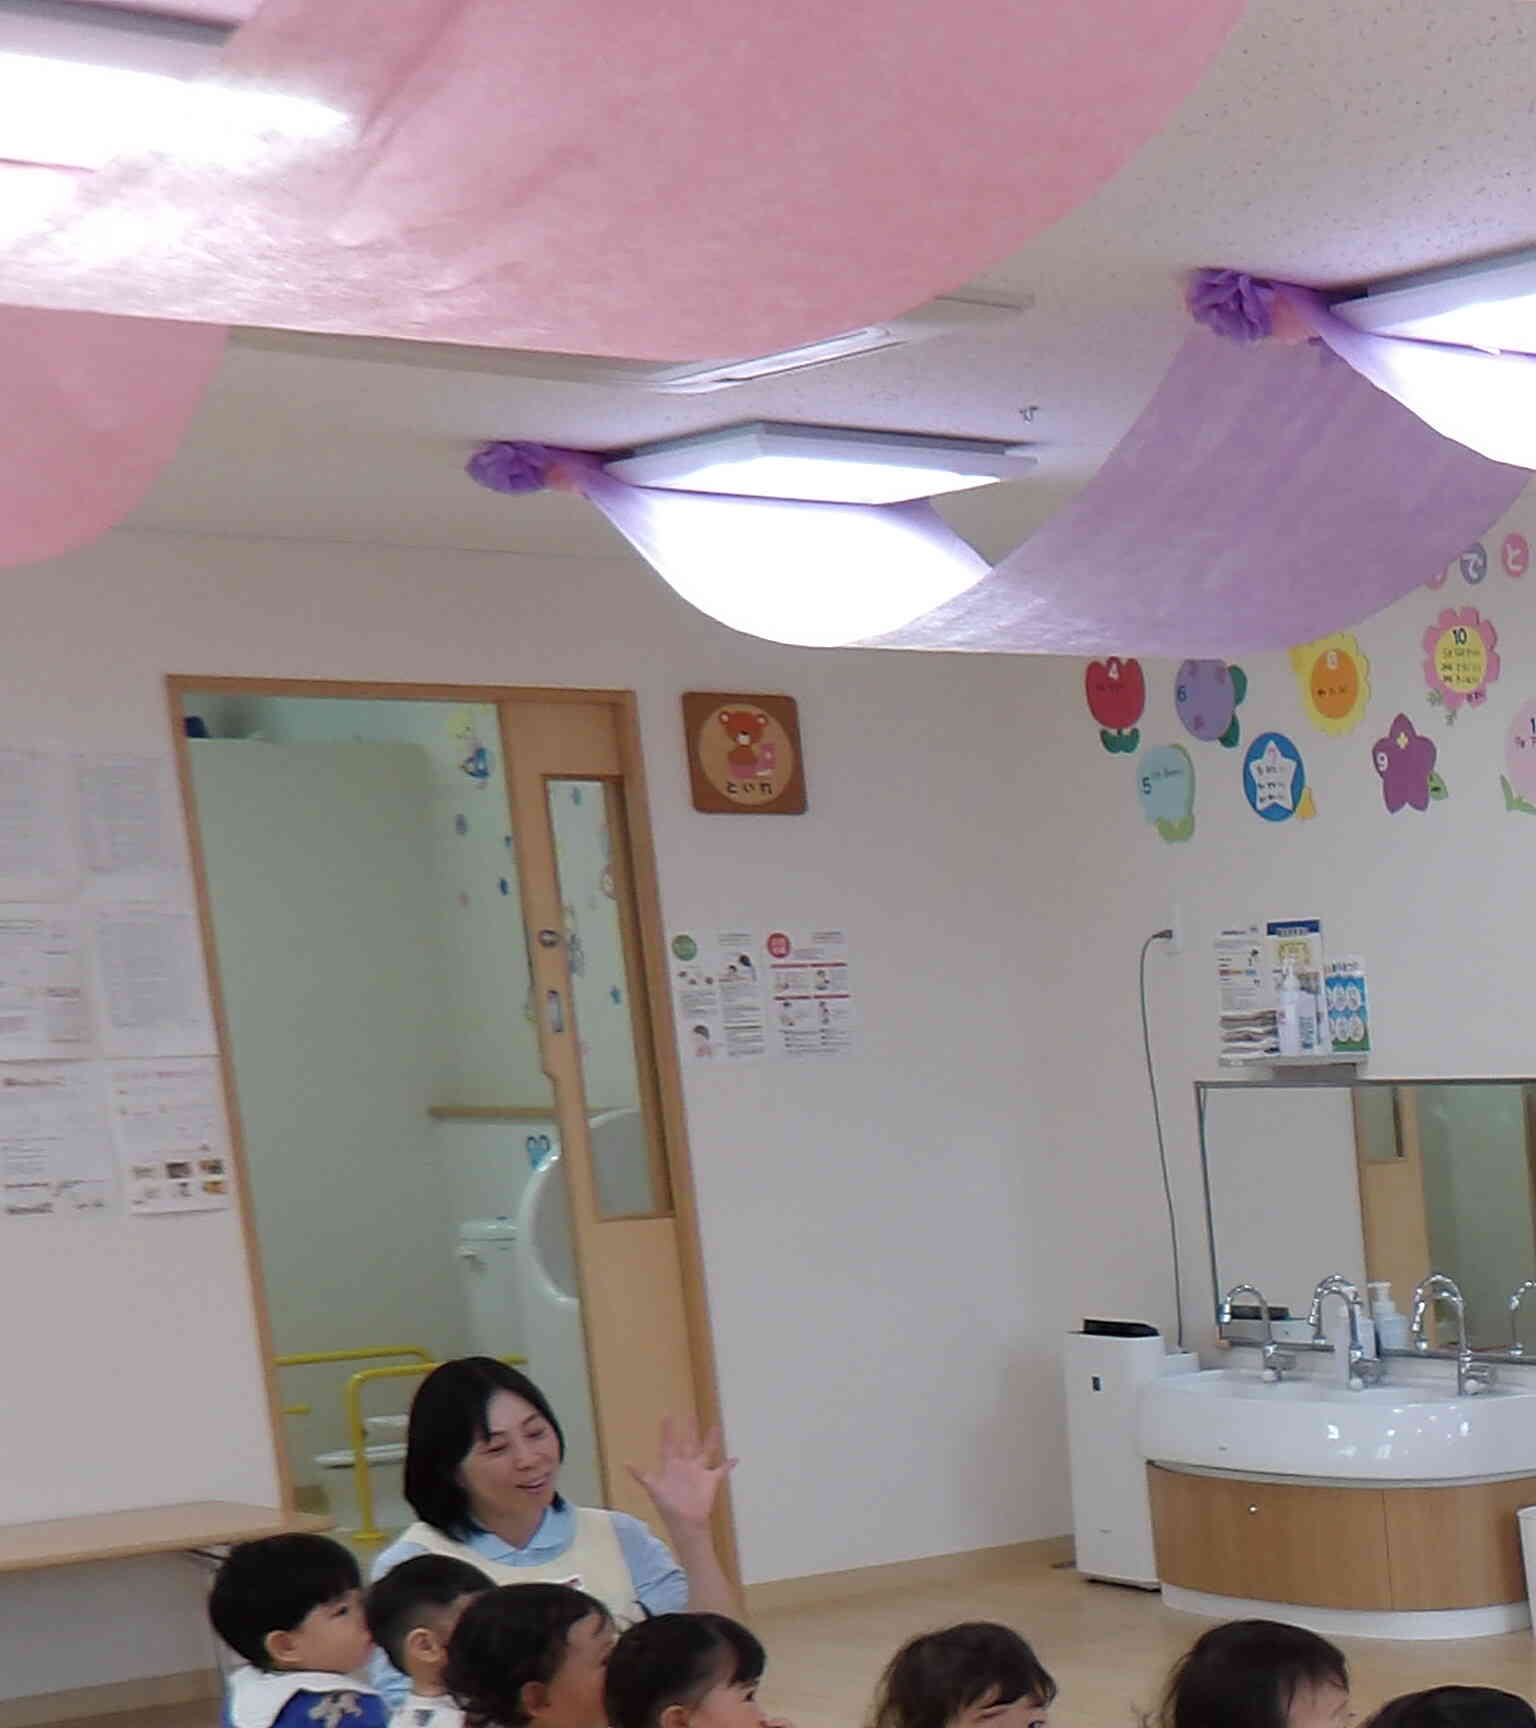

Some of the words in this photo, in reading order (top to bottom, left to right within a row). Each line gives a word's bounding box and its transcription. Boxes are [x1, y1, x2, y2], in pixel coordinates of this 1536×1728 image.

[1452, 627, 1468, 645] 10
[1377, 752, 1388, 772] 9
[1142, 776, 1152, 795] 5
